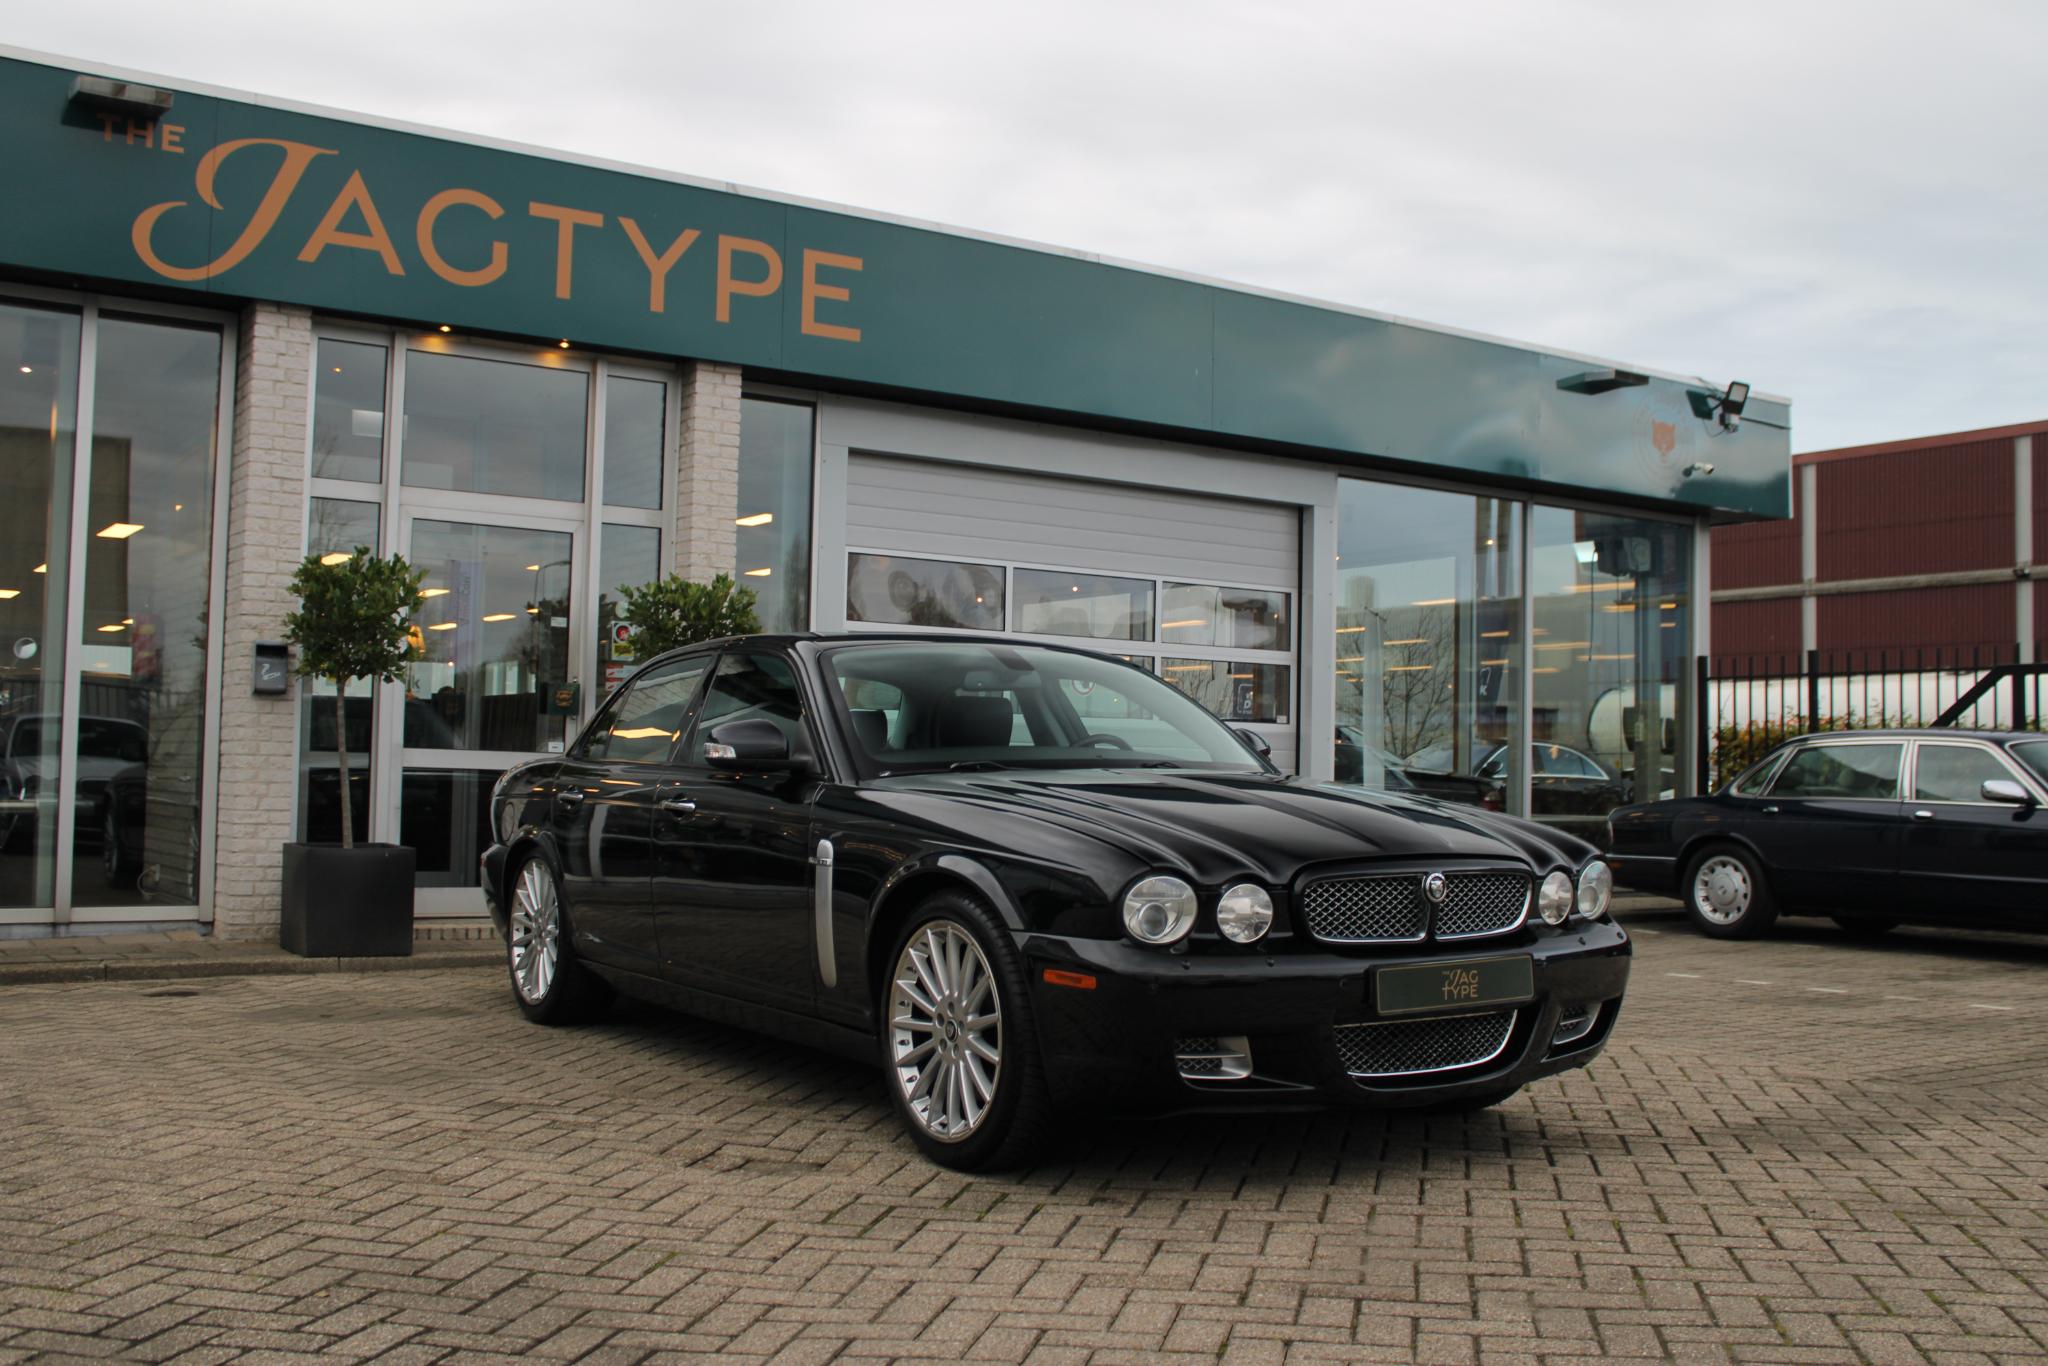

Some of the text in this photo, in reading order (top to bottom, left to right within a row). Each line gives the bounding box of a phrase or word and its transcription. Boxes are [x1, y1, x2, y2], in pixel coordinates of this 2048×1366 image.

[96, 112, 186, 153] THE
[131, 137, 864, 343] JAGTYPE
[1441, 984, 1479, 1001] TYPE
[1444, 968, 1479, 987] JAG
